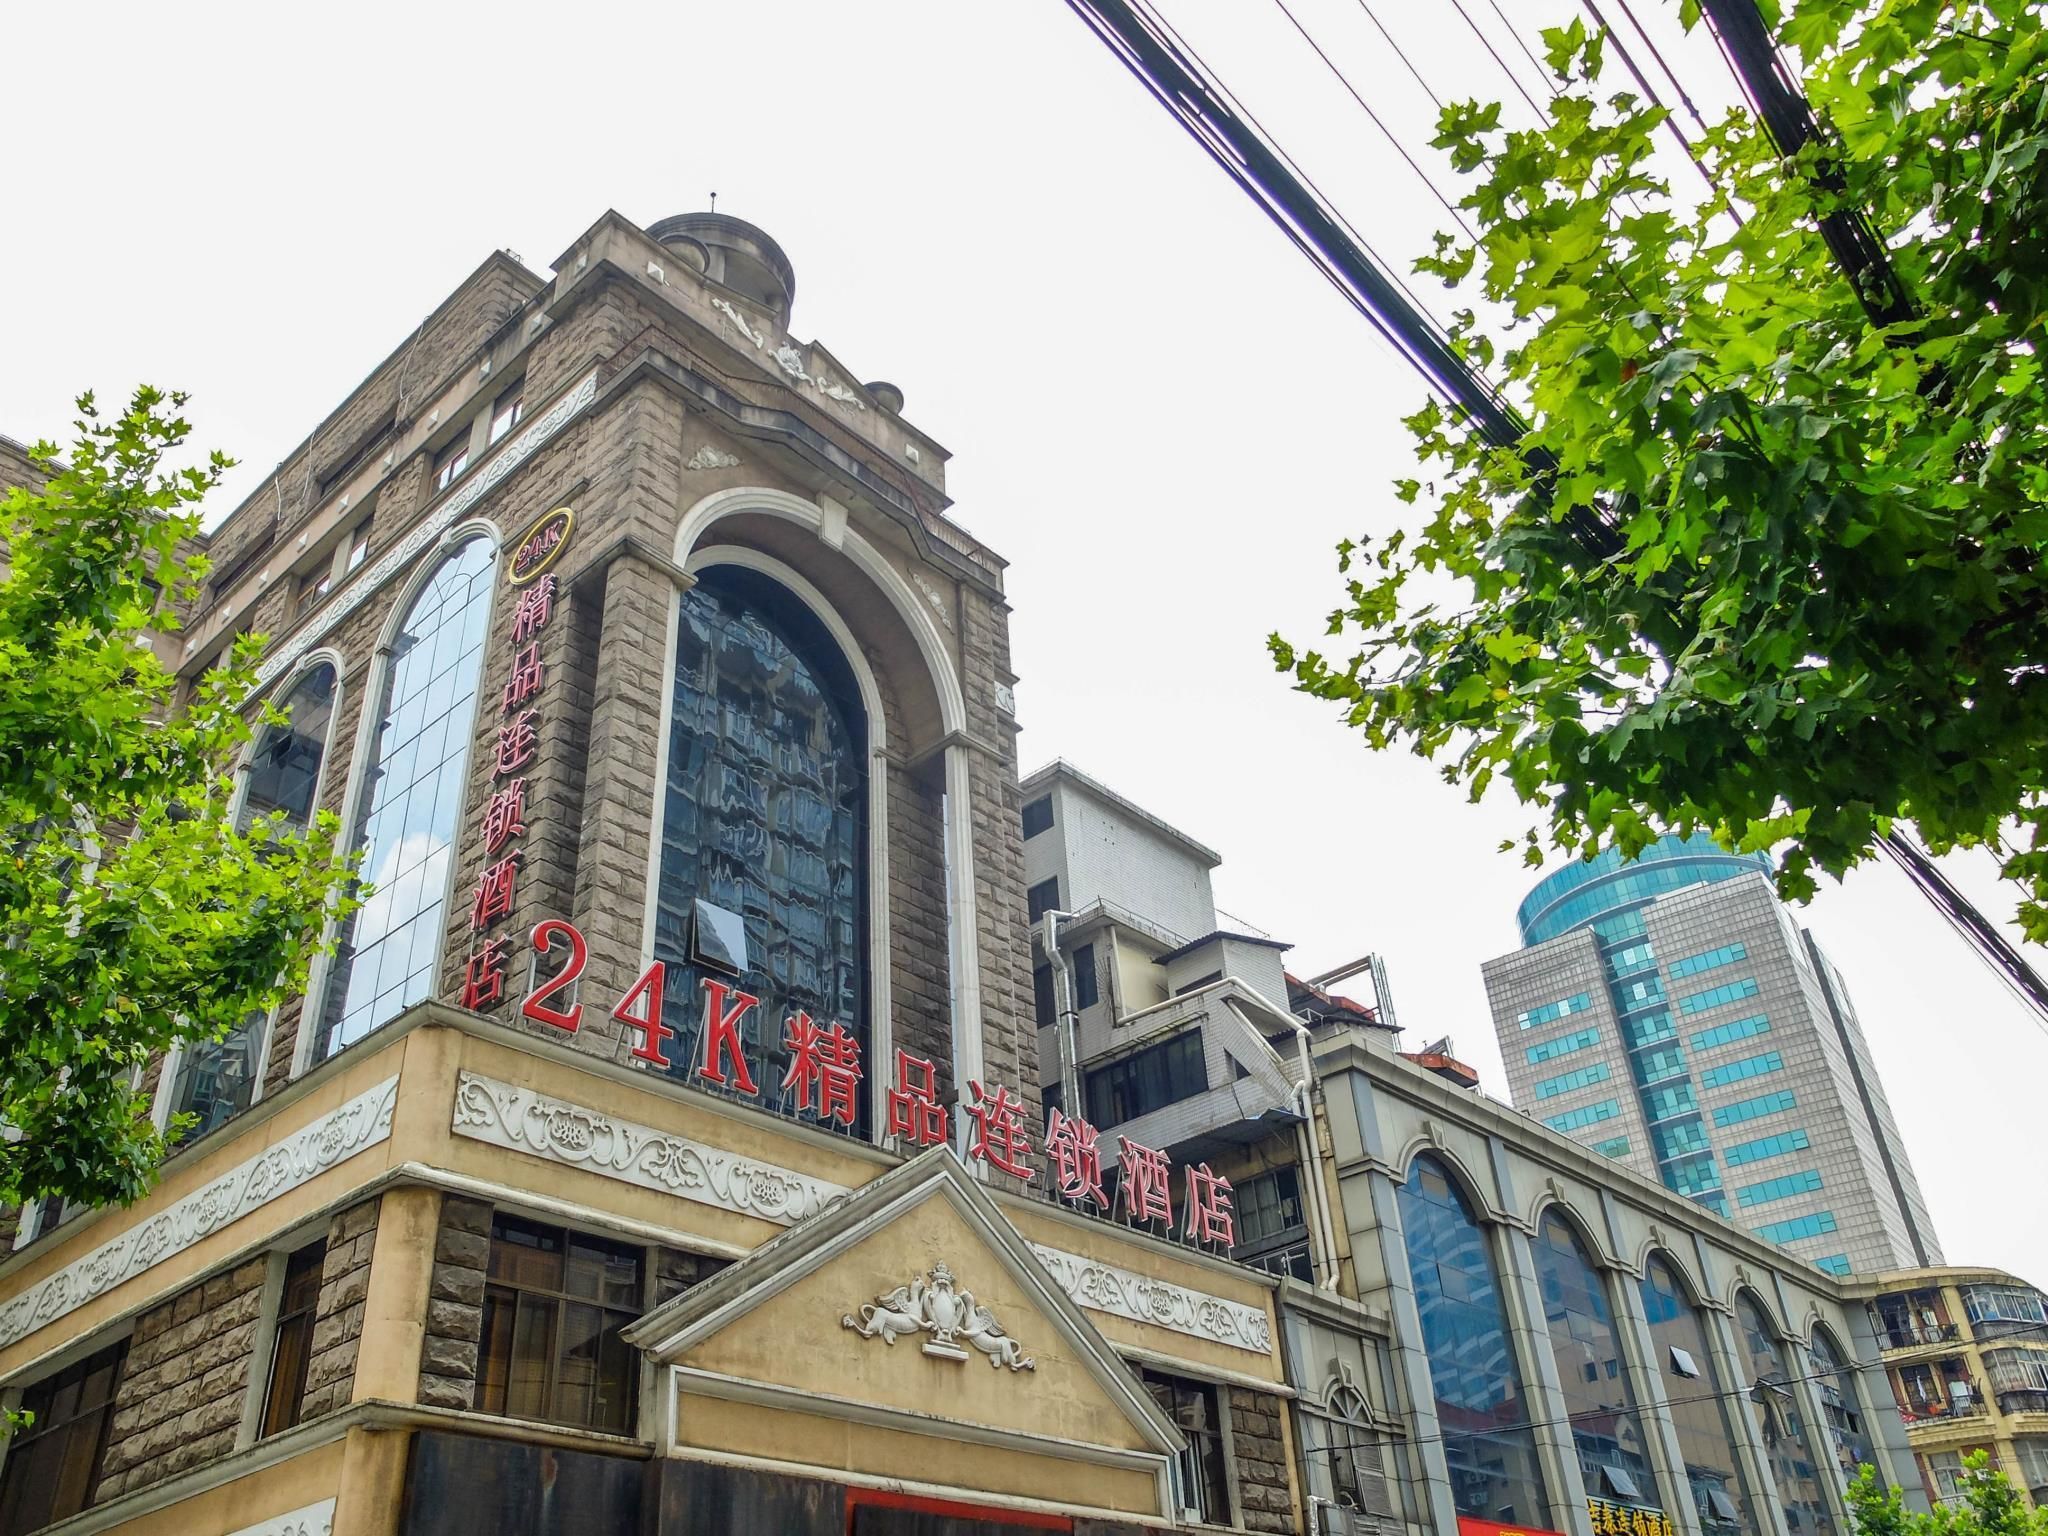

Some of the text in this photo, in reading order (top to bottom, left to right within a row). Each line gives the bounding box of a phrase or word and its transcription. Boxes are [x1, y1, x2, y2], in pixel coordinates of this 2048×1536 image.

[515, 519, 564, 573] 24K
[461, 573, 558, 1011] 精品连锁酒店
